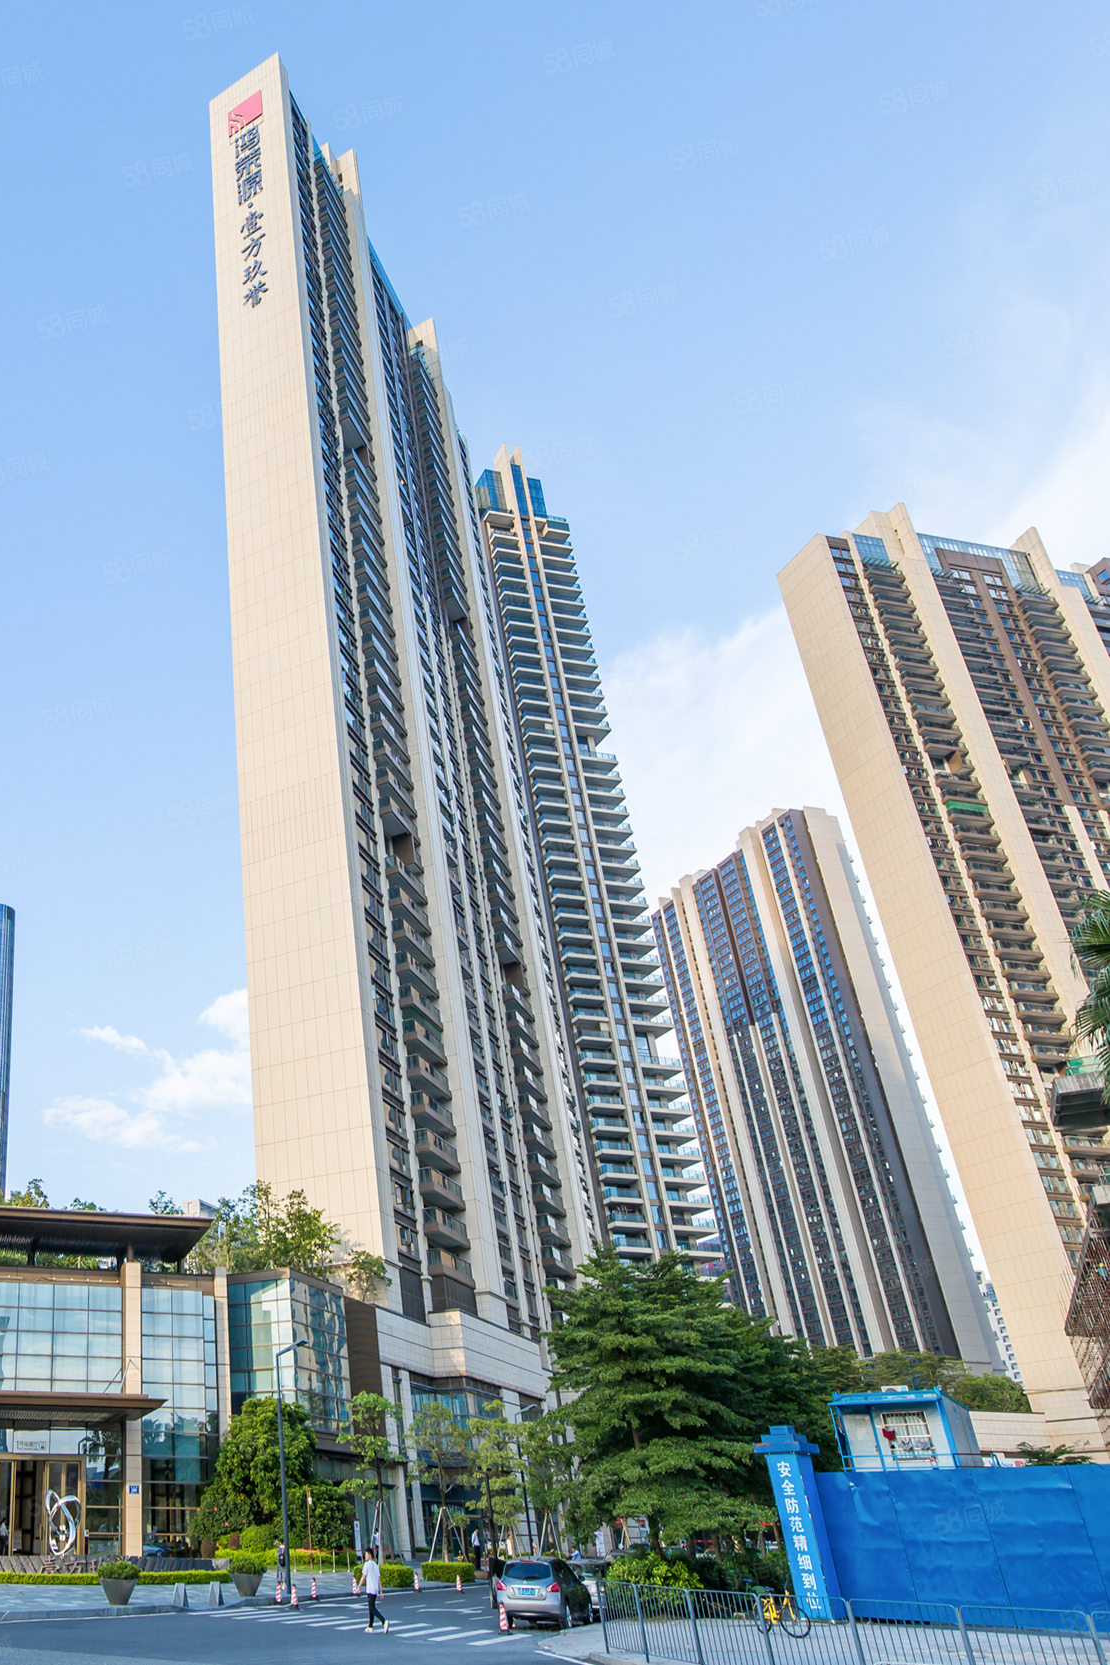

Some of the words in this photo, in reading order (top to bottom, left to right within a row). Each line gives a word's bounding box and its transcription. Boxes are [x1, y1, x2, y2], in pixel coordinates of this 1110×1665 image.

[776, 1460, 822, 1611] 安全防范精细到位
